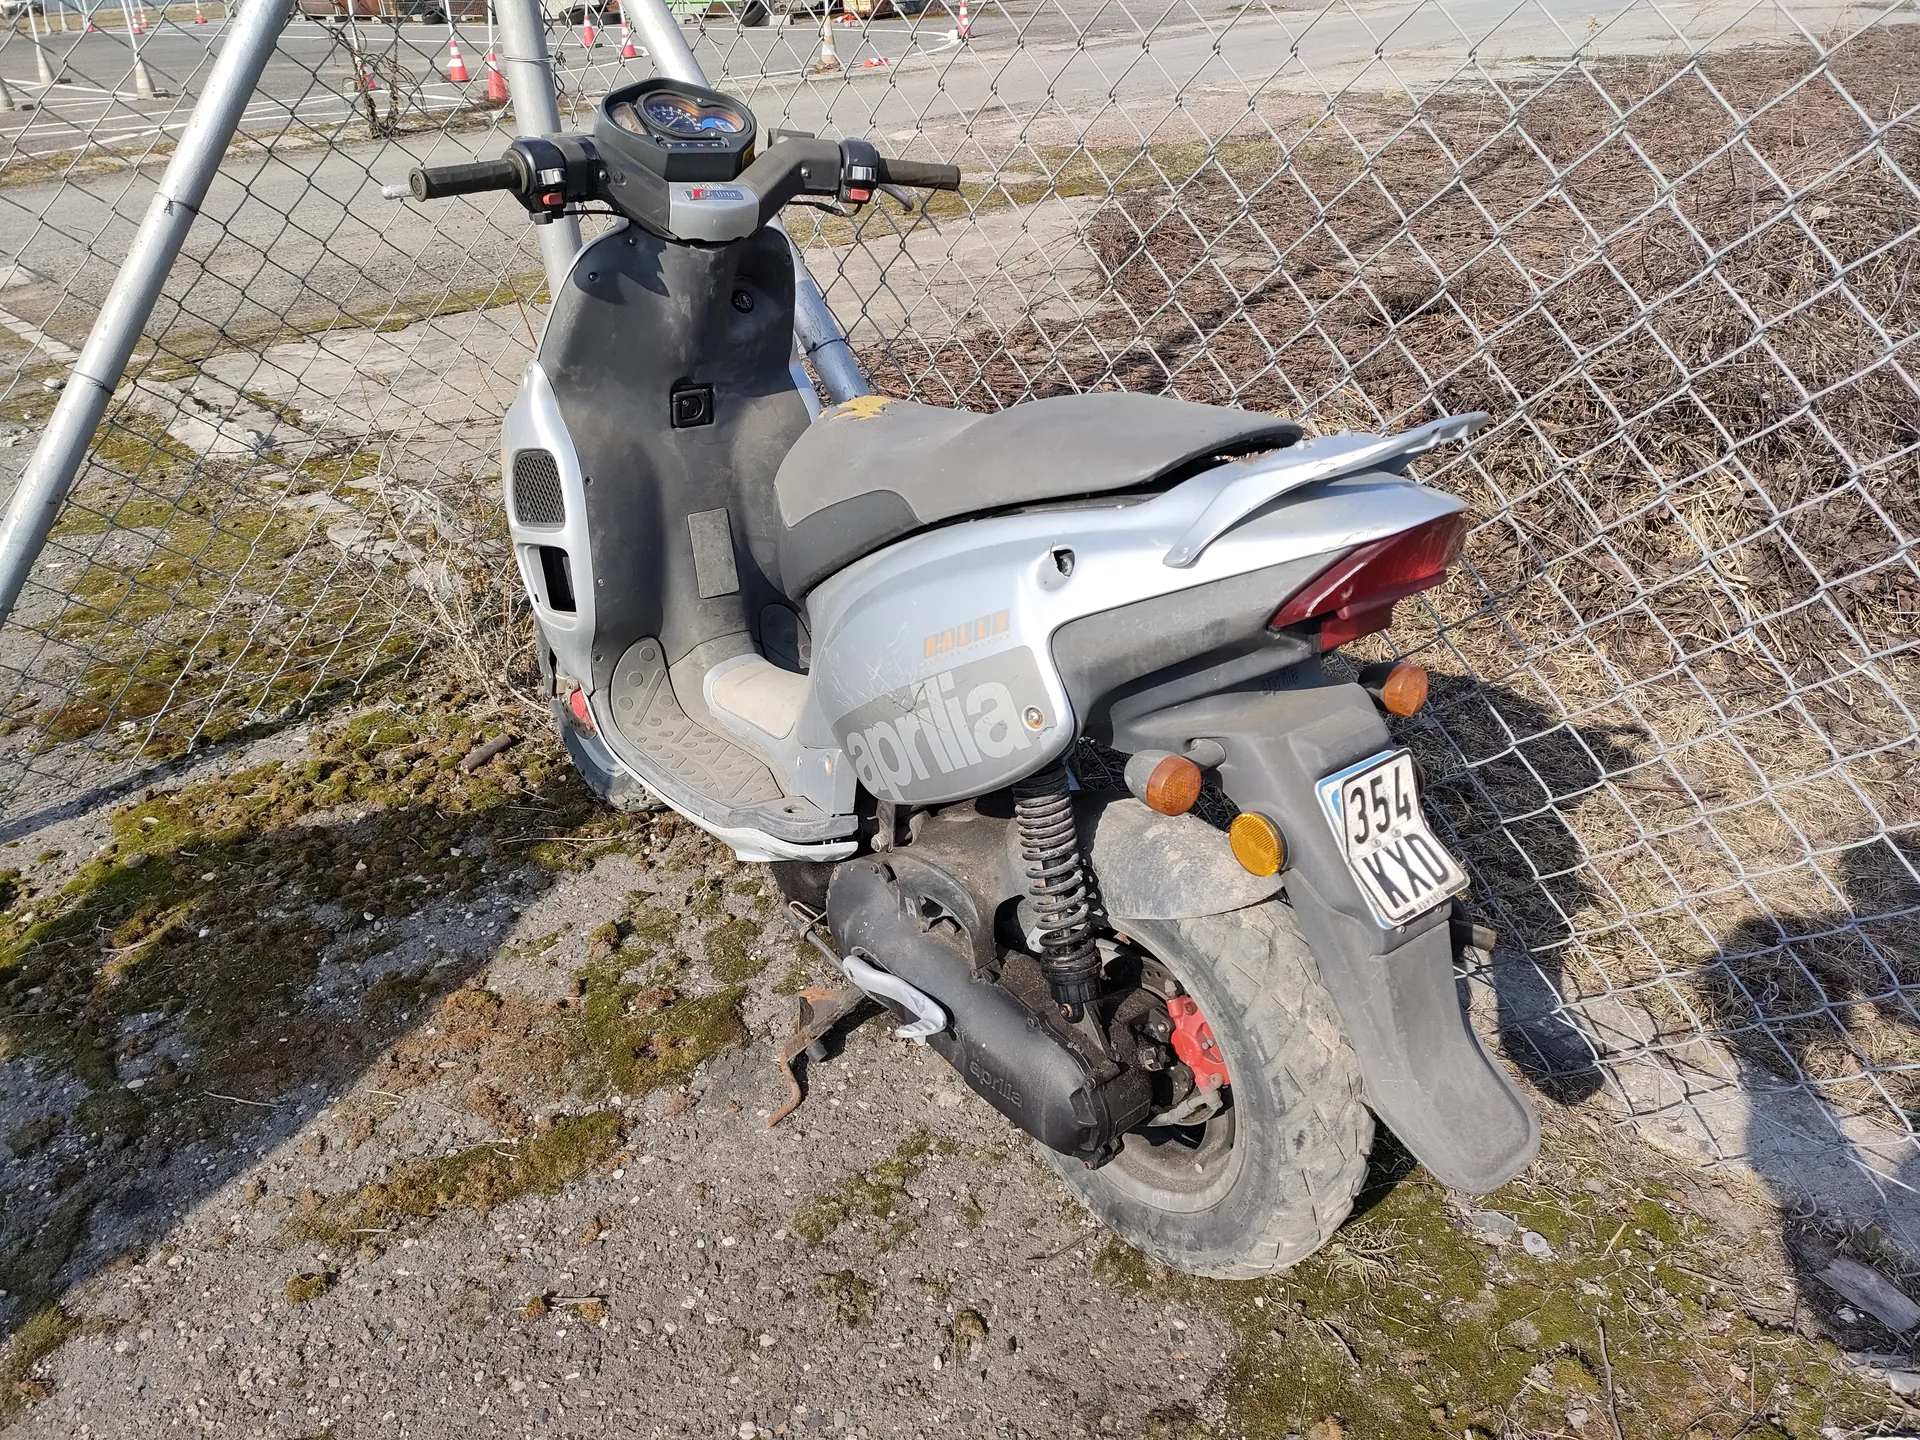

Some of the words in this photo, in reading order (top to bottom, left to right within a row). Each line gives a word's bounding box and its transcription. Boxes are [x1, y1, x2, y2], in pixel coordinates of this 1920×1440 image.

[925, 610, 1007, 659] RALLY
[846, 670, 1033, 801] aprilia
[1350, 766, 1411, 844] 354
[1362, 833, 1449, 909] KXD
[969, 1060, 1023, 1108] aprilia
